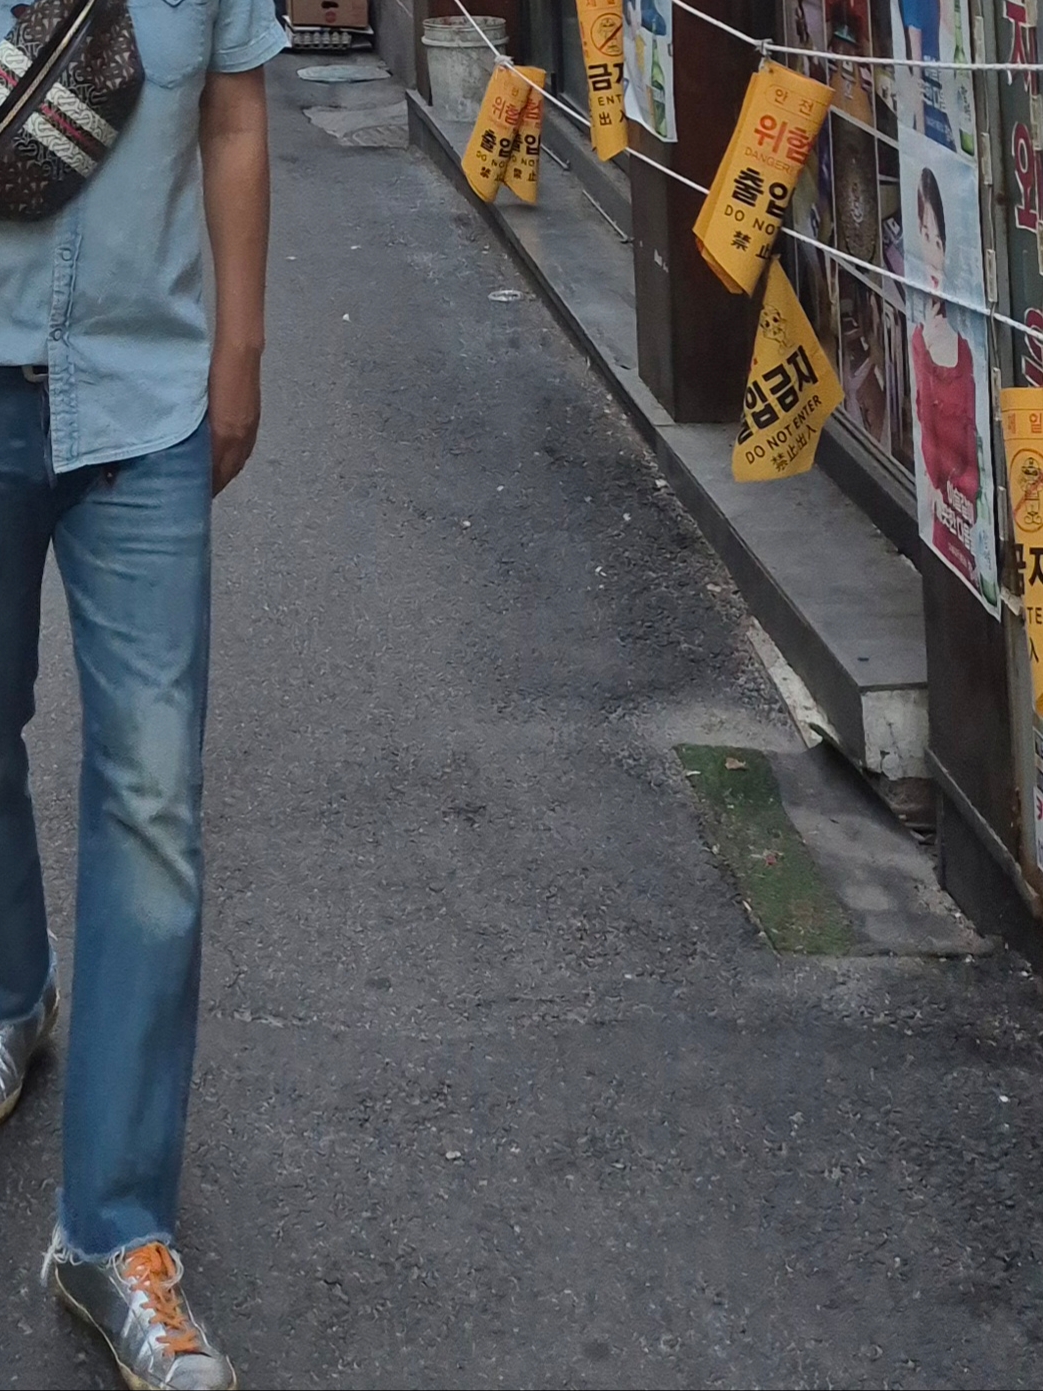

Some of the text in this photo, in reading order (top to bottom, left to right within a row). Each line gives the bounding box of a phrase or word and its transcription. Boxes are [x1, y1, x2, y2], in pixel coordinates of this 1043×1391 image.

[774, 87, 814, 117] 안전
[754, 114, 813, 165] 위험
[724, 204, 745, 222] DO
[745, 394, 823, 465] DO NOT ENTER
[770, 423, 818, 473] 禁止出入
